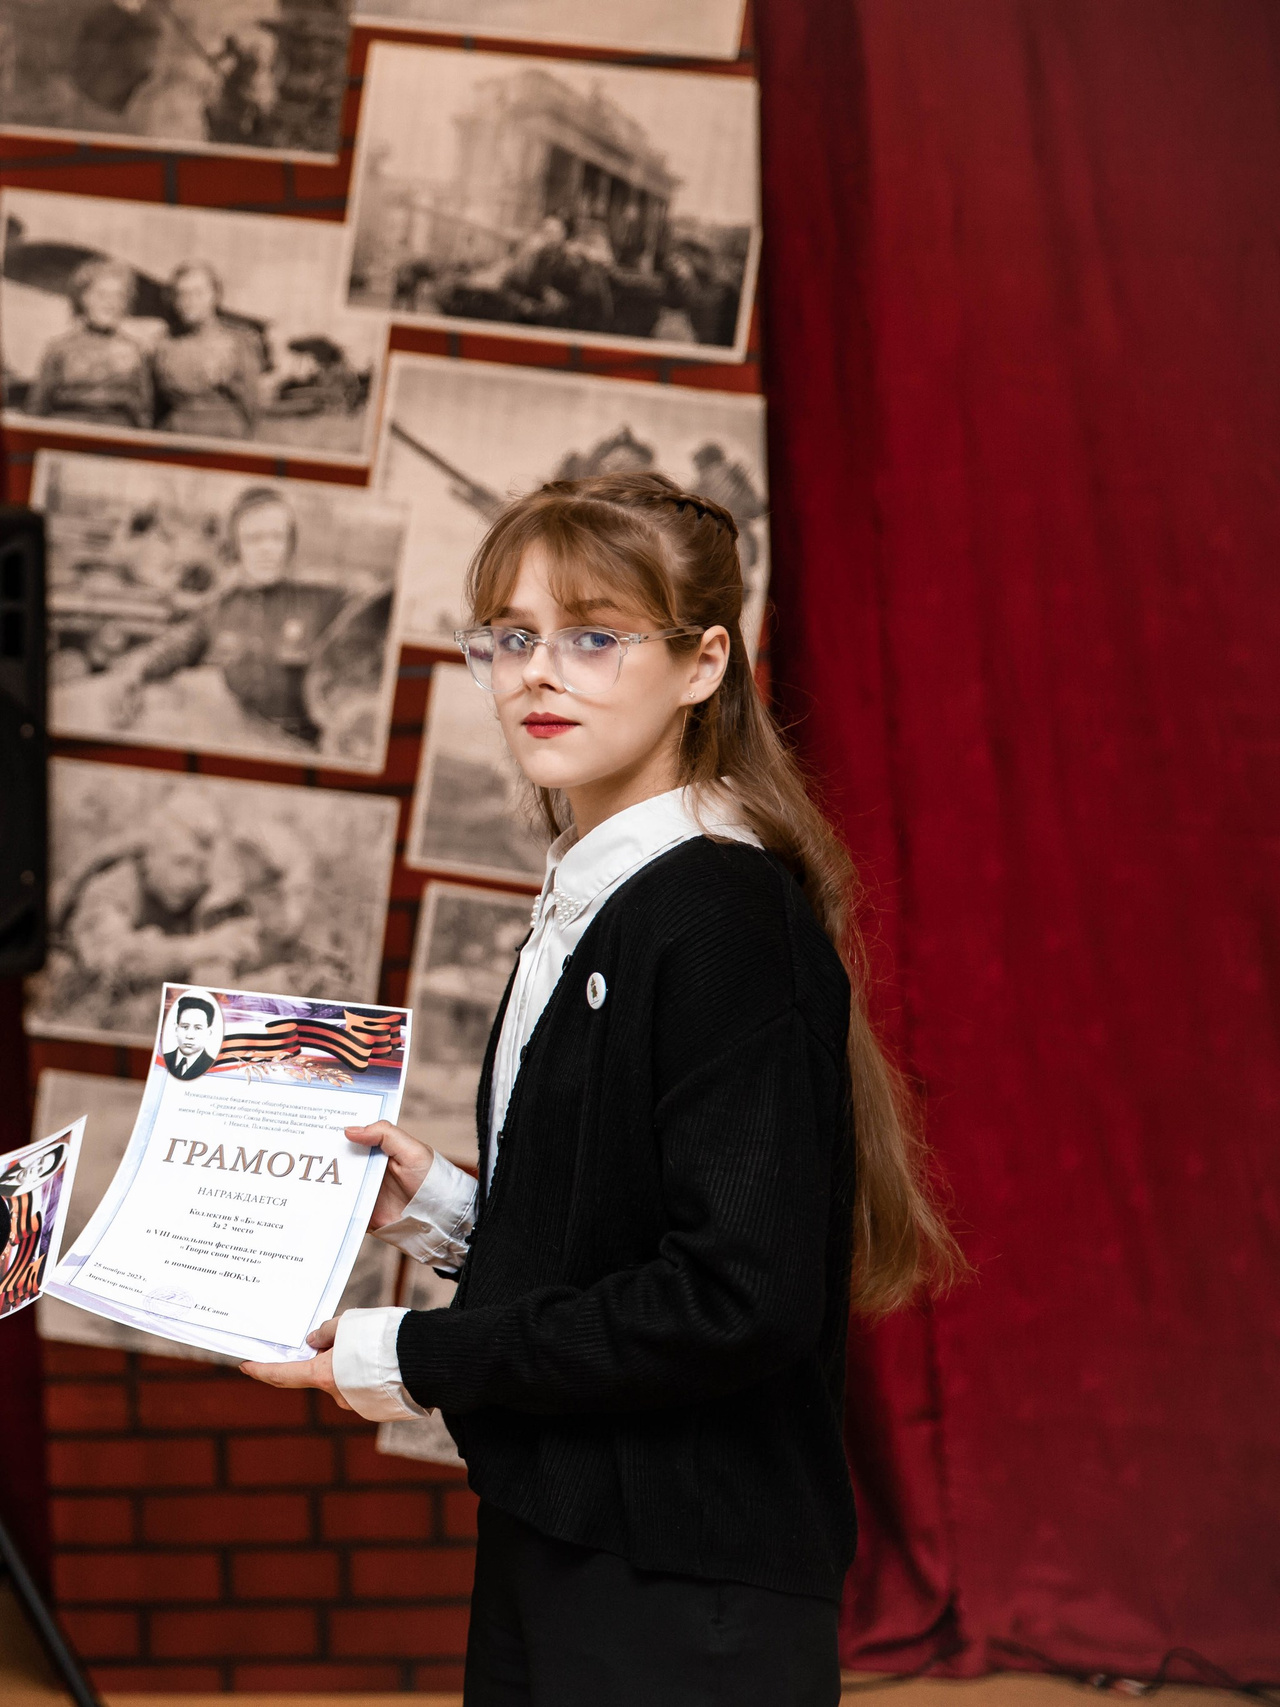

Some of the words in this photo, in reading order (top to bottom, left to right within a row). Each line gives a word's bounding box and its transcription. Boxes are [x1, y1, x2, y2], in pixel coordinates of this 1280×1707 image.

[184, 1091, 229, 1102] Муниципальное
[230, 1097, 260, 1105] бюджетное
[262, 1100, 322, 1112] общеобразовательное
[324, 1108, 357, 1117] учреждение
[237, 1106, 298, 1118] общеобразовательная
[212, 1111, 242, 1119] Советского
[251, 1123, 281, 1132] Псковской
[282, 1127, 305, 1135] области
[162, 1137, 343, 1186] ГРАМОТА
[197, 1186, 288, 1207] НАГРАЖДАЕТСЯ
[189, 1208, 232, 1221] Коллектив
[240, 1217, 255, 1225] «Б»
[256, 1220, 284, 1230] класса
[212, 1221, 221, 1229] За
[231, 1226, 254, 1235] место
[154, 1228, 171, 1238] VIII
[171, 1234, 214, 1247] школьном
[214, 1241, 258, 1255] фестивале
[259, 1250, 304, 1263] творчества
[179, 1244, 210, 1255] «Твори
[210, 1250, 230, 1259] свои
[231, 1255, 262, 1265] мечты»
[102, 1265, 126, 1276] ноября
[126, 1272, 142, 1280] 2023
[171, 1261, 218, 1275] номинации
[218, 1270, 261, 1283] «ВОКАЛ»
[85, 1273, 118, 1287] Директор
[118, 1284, 143, 1294] школы
